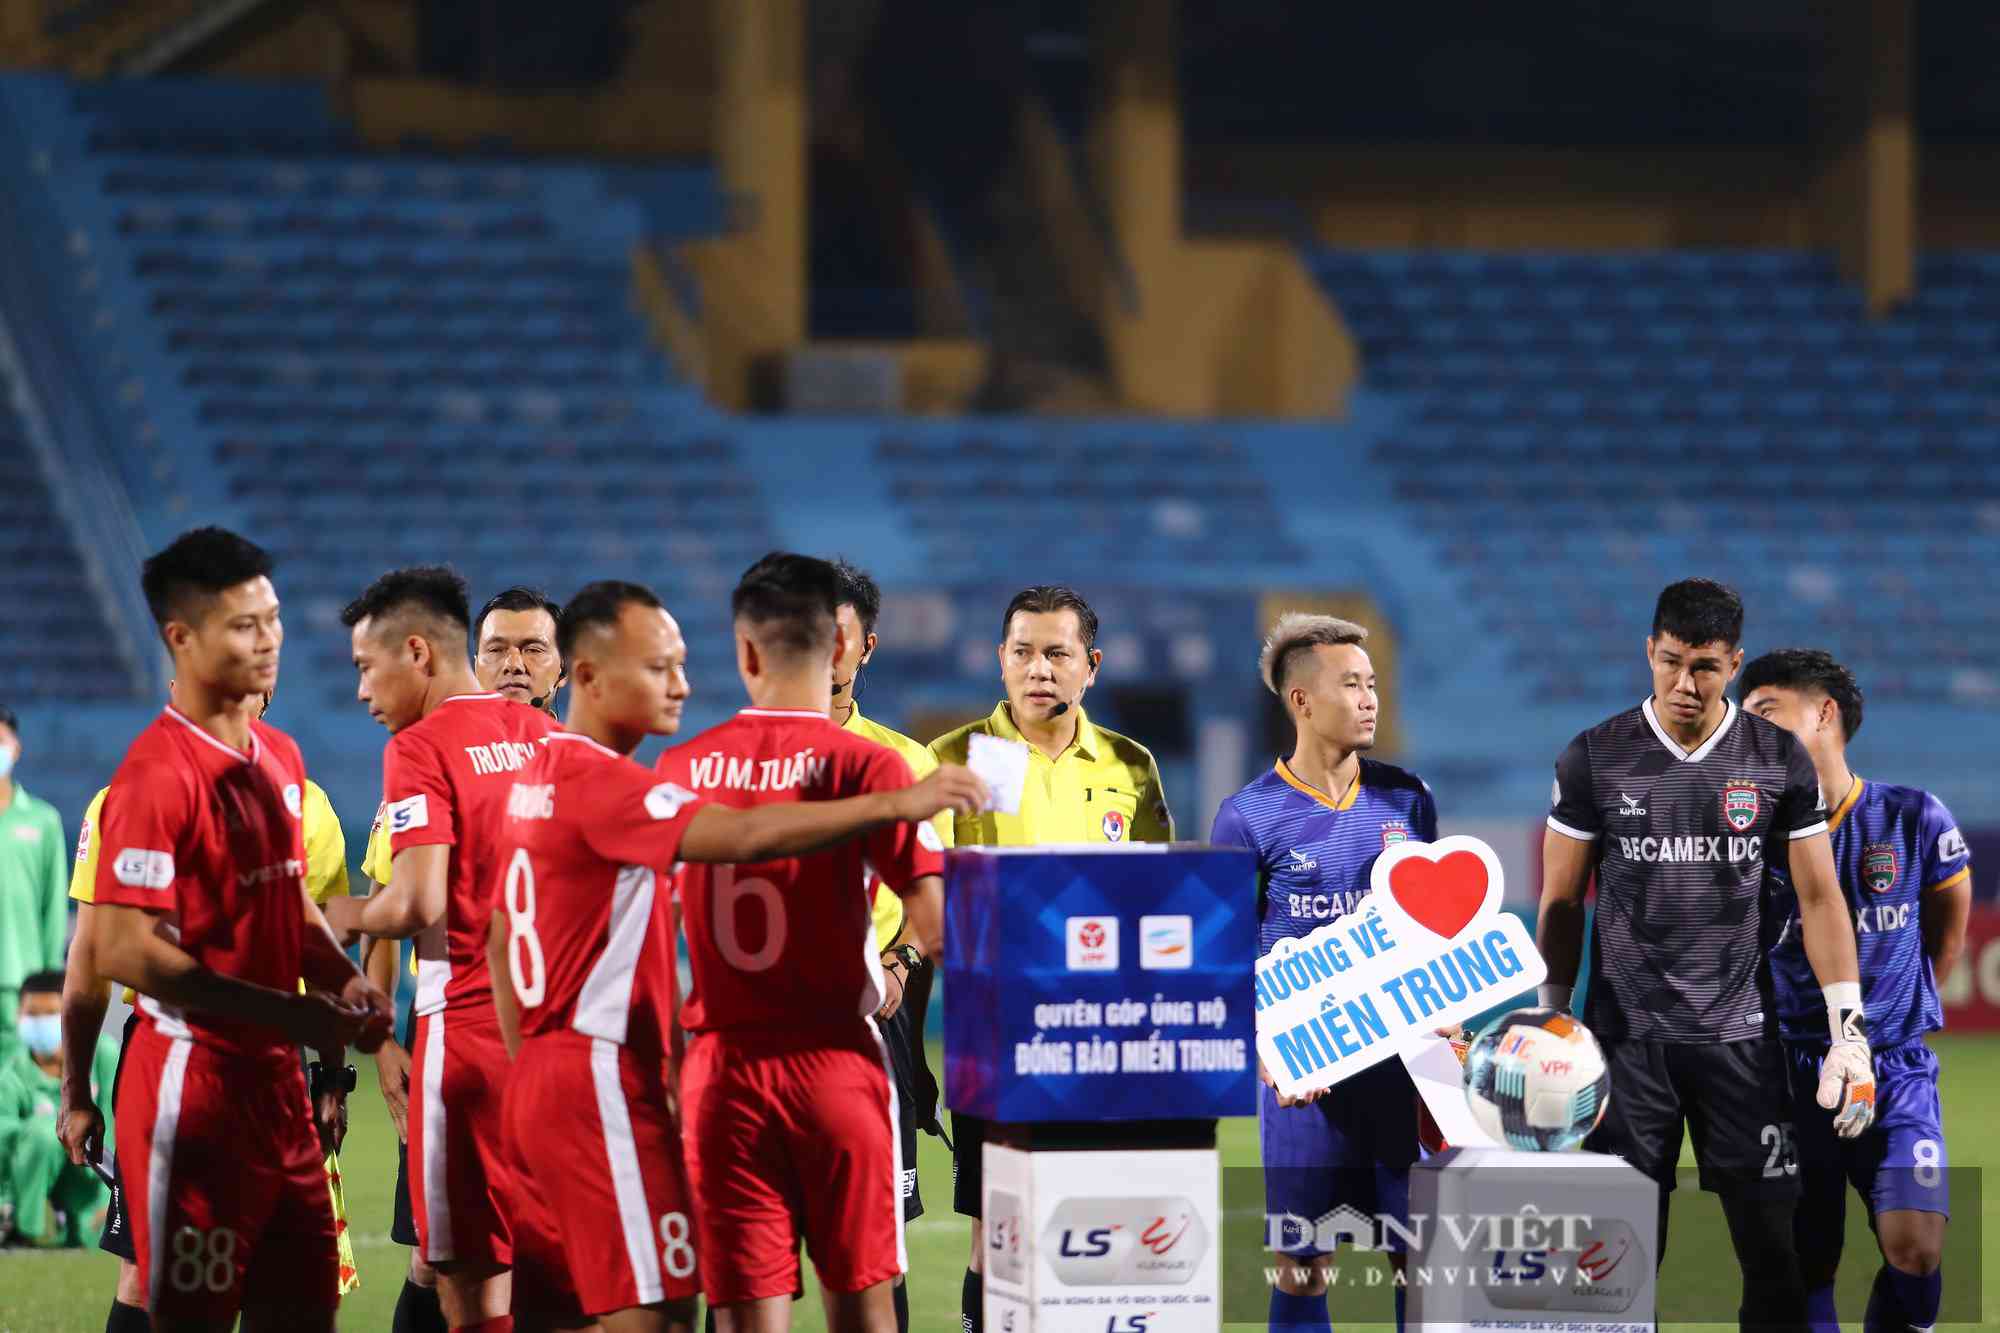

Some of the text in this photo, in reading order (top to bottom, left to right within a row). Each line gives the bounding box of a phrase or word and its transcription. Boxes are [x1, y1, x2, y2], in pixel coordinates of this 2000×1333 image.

[689, 751, 724, 789] VŨ
[1618, 836, 1761, 862] BECAMEX IDC
[712, 861, 788, 973] 6
[1288, 889, 1373, 919] BECAM
[1875, 903, 1909, 932] IDC
[504, 847, 547, 1009] 8
[1347, 905, 1397, 960] VỀ
[1033, 998, 1102, 1030] QUYÊN
[1104, 997, 1148, 1027] GÓP
[1196, 996, 1228, 1030] HỘ
[1271, 929, 1525, 1081] MIỀN TRUNG
[1178, 1038, 1247, 1072] TRUNG
[1912, 1138, 1942, 1189] 8
[170, 1225, 236, 1293] 88
[659, 1211, 697, 1280] 8
[1059, 1228, 1113, 1258] LS
